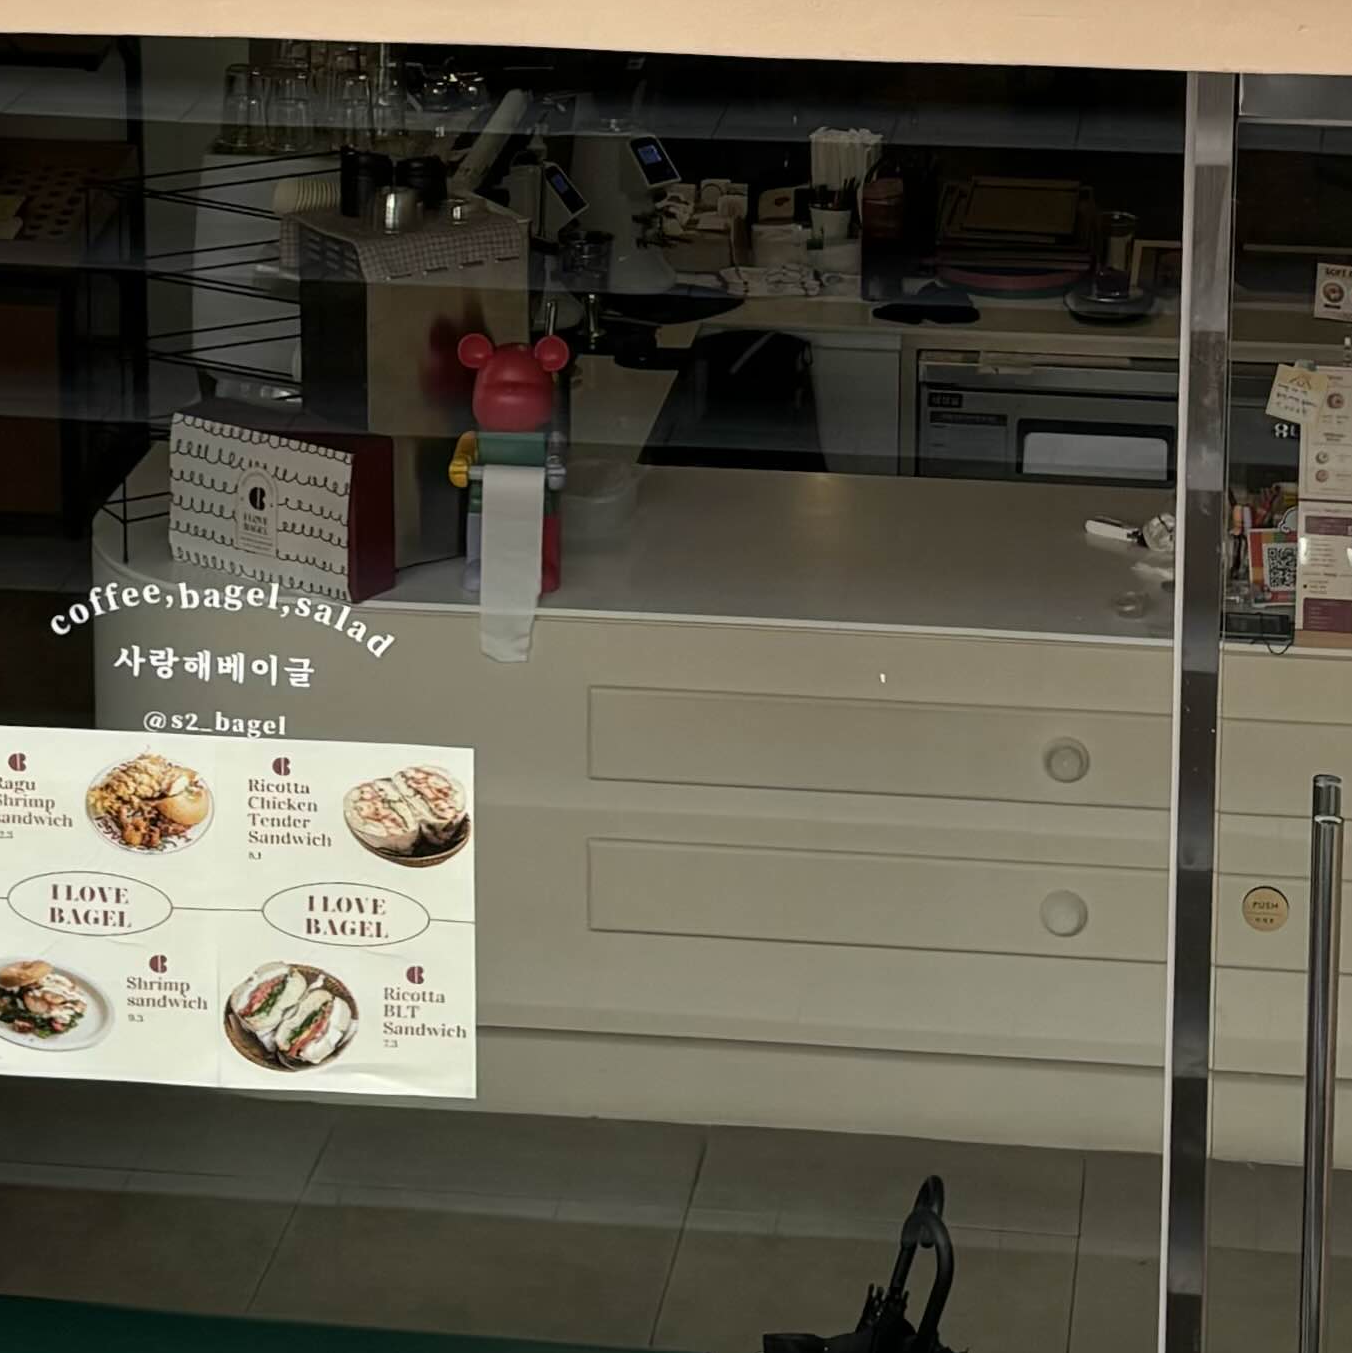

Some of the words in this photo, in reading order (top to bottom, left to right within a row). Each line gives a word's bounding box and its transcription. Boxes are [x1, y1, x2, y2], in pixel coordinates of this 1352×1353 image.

[113, 645, 315, 688] 사랑해베이글
[143, 711, 286, 738] @s2_bagel
[248, 778, 311, 795] Ricotta
[248, 796, 318, 813] Chicken
[248, 813, 311, 829] Tender
[248, 830, 332, 848] Sandwich
[51, 884, 59, 901] I
[65, 884, 129, 904] LOVE
[308, 895, 315, 912] I
[322, 895, 386, 915] LOVE
[49, 906, 132, 928] BAGEL
[306, 918, 389, 939] BAGEL
[126, 976, 191, 997] Shrimp
[383, 987, 445, 1003] Ricotta
[127, 994, 208, 1010] sandwich
[383, 1004, 420, 1018] BLT
[383, 1021, 467, 1039] Sandwich
